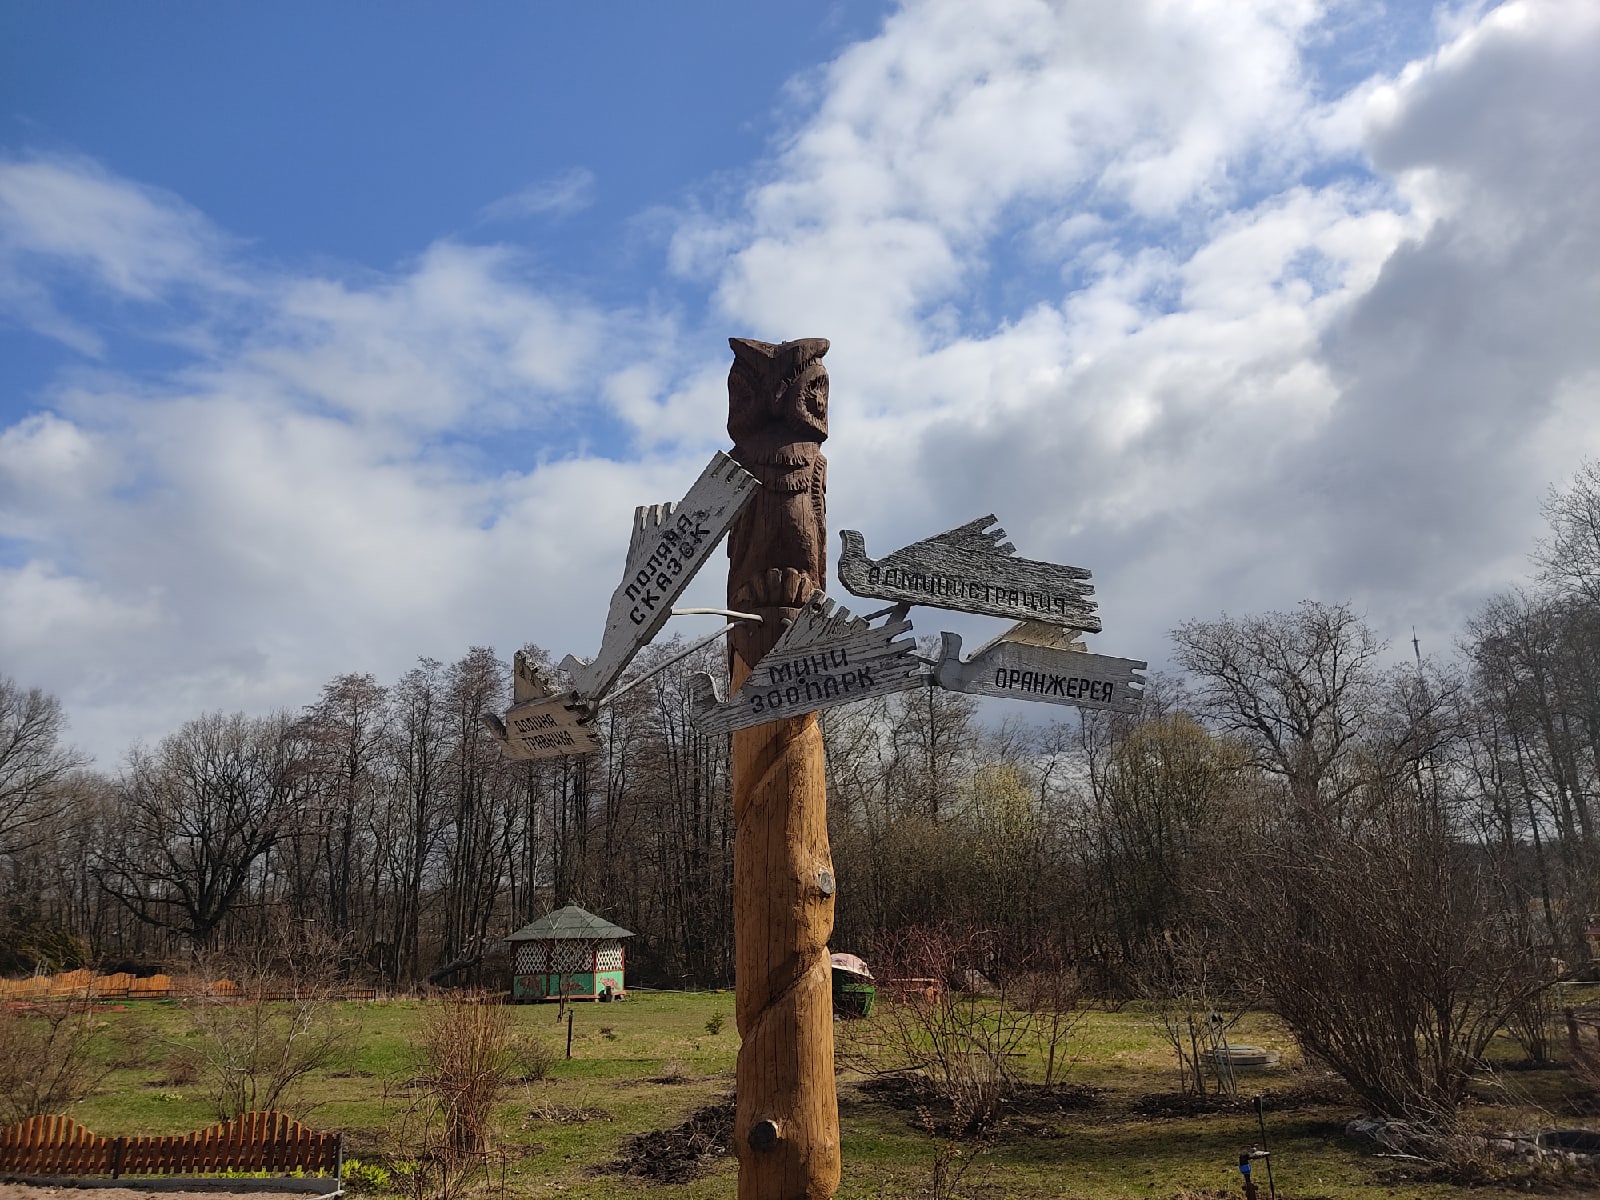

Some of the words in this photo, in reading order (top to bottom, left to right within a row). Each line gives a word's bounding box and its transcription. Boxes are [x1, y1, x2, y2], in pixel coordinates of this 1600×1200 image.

[625, 513, 692, 602] ПОЛЯНА
[868, 566, 1067, 614] АДМИНИСТРАЦИЯ
[769, 648, 848, 684] МИНИ
[995, 667, 1114, 703] ОРАНЖЕРЕЯ
[750, 666, 875, 714] ЗООПАРК
[514, 713, 558, 733] ДОЛИНА
